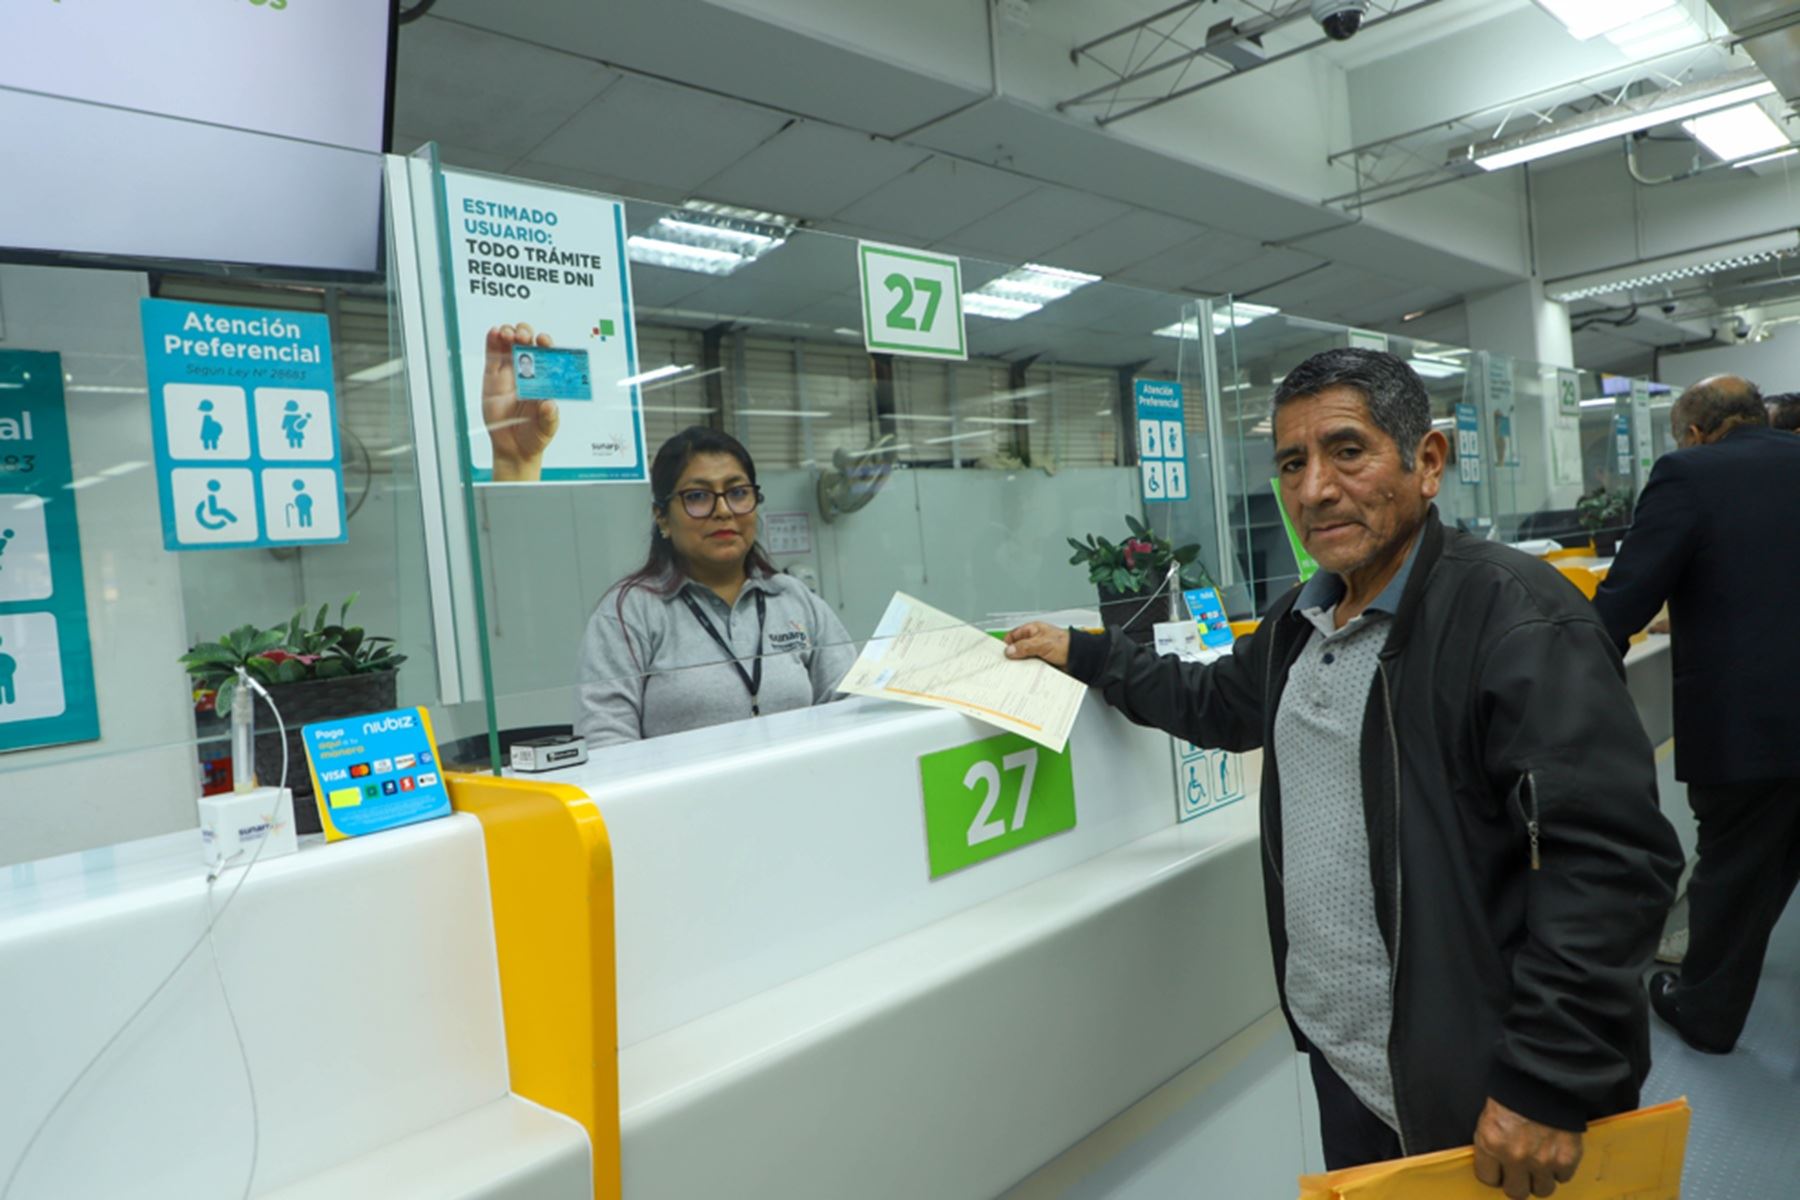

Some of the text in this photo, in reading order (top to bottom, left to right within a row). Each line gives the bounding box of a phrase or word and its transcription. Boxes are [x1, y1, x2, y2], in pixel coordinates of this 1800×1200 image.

[463, 198, 558, 226] ESTIMADO
[464, 219, 553, 245] USUARIO:
[465, 239, 602, 270] TODO TRÁMITE
[468, 259, 595, 288] REQUIERE DNI
[470, 276, 531, 300] FÍSICO
[883, 273, 943, 333] 27
[183, 312, 301, 339] Atención
[164, 334, 321, 364] Preferencial
[321, 768, 348, 783] VISA
[963, 747, 1039, 847] 27
